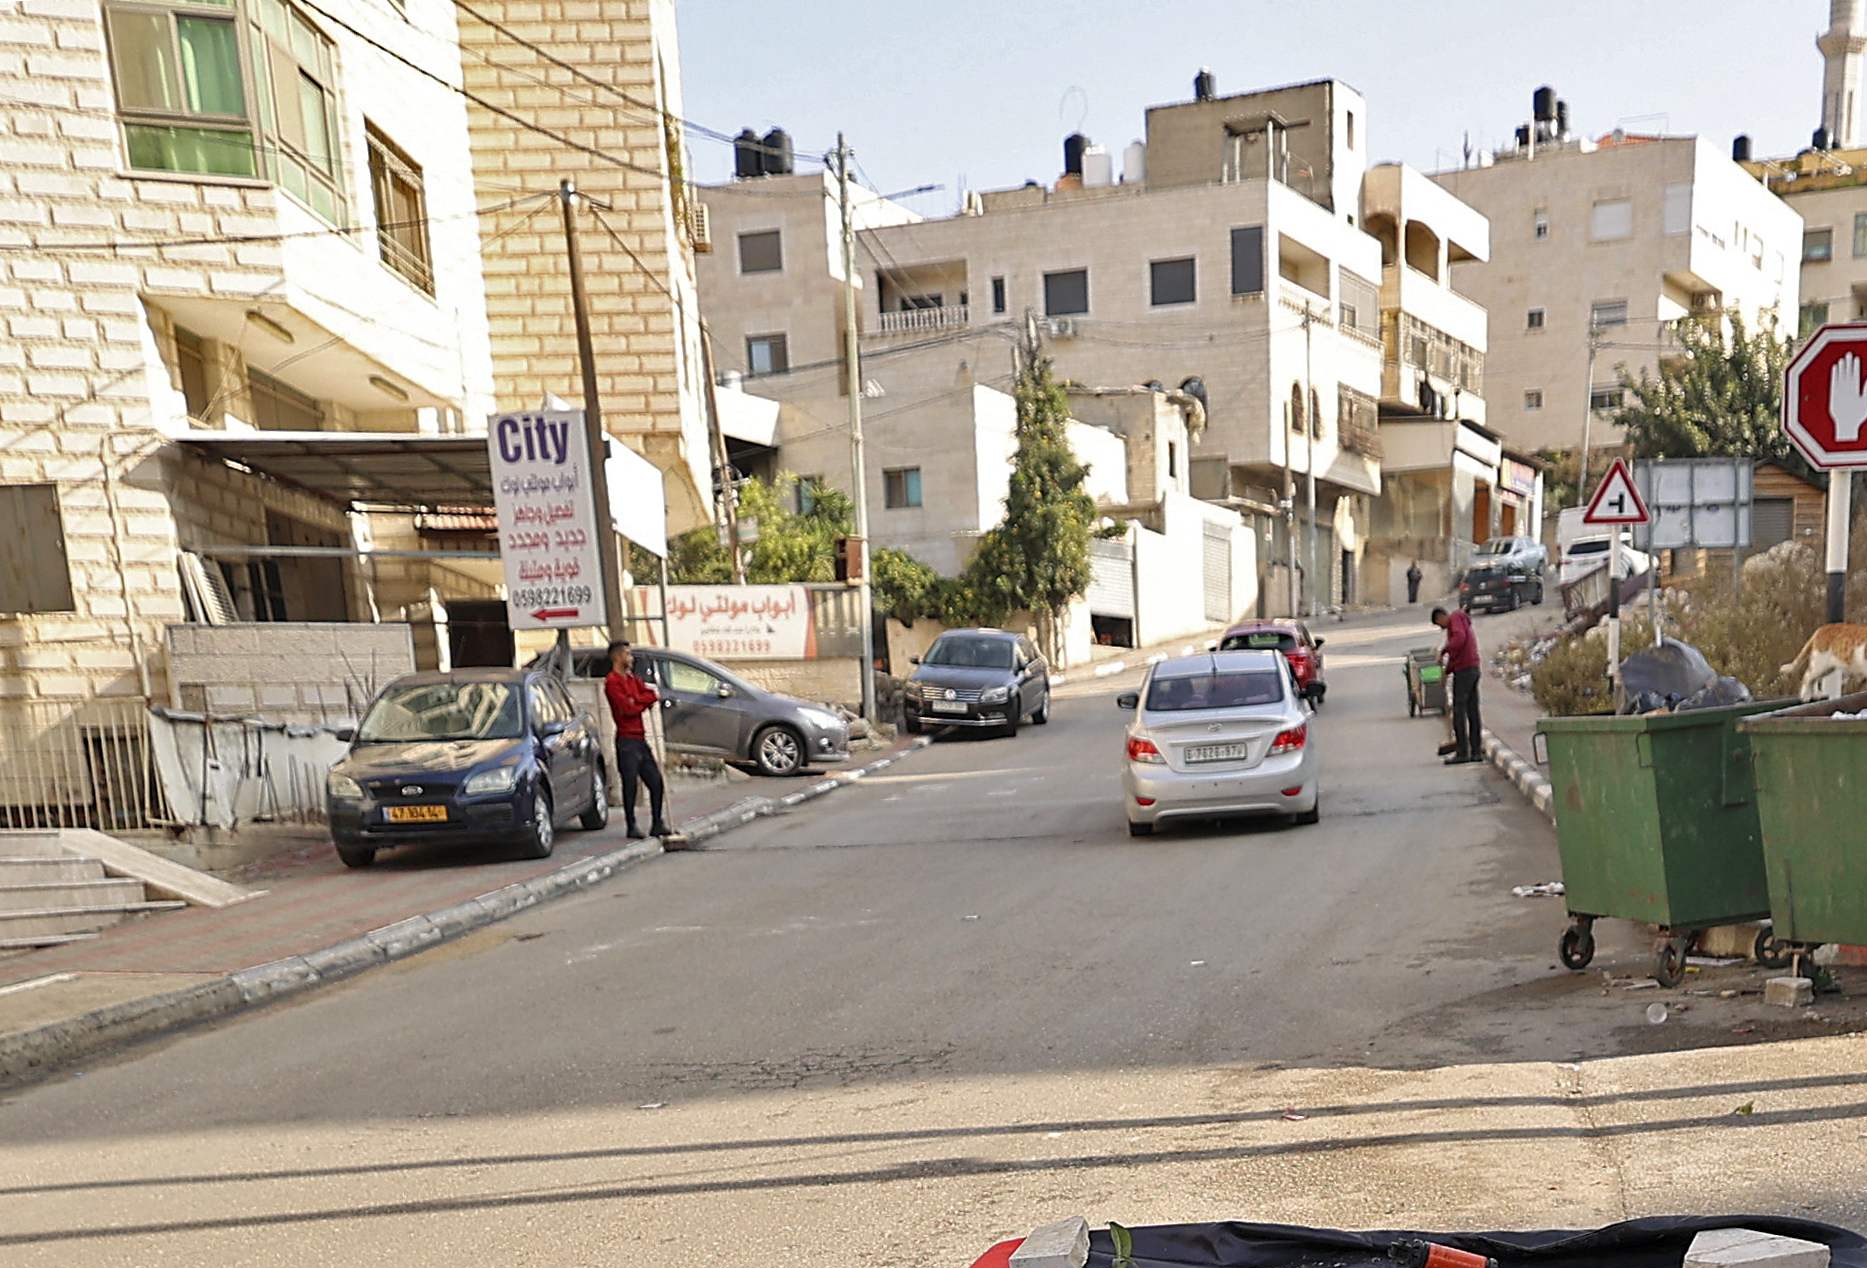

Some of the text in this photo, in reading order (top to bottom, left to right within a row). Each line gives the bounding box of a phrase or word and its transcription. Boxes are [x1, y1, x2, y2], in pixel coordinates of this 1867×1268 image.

[498, 417, 568, 464] City
[555, 529, 587, 553] جديد
[512, 585, 591, 608] 0598221699
[699, 594, 748, 623] مولتي
[752, 590, 796, 621] أبواب
